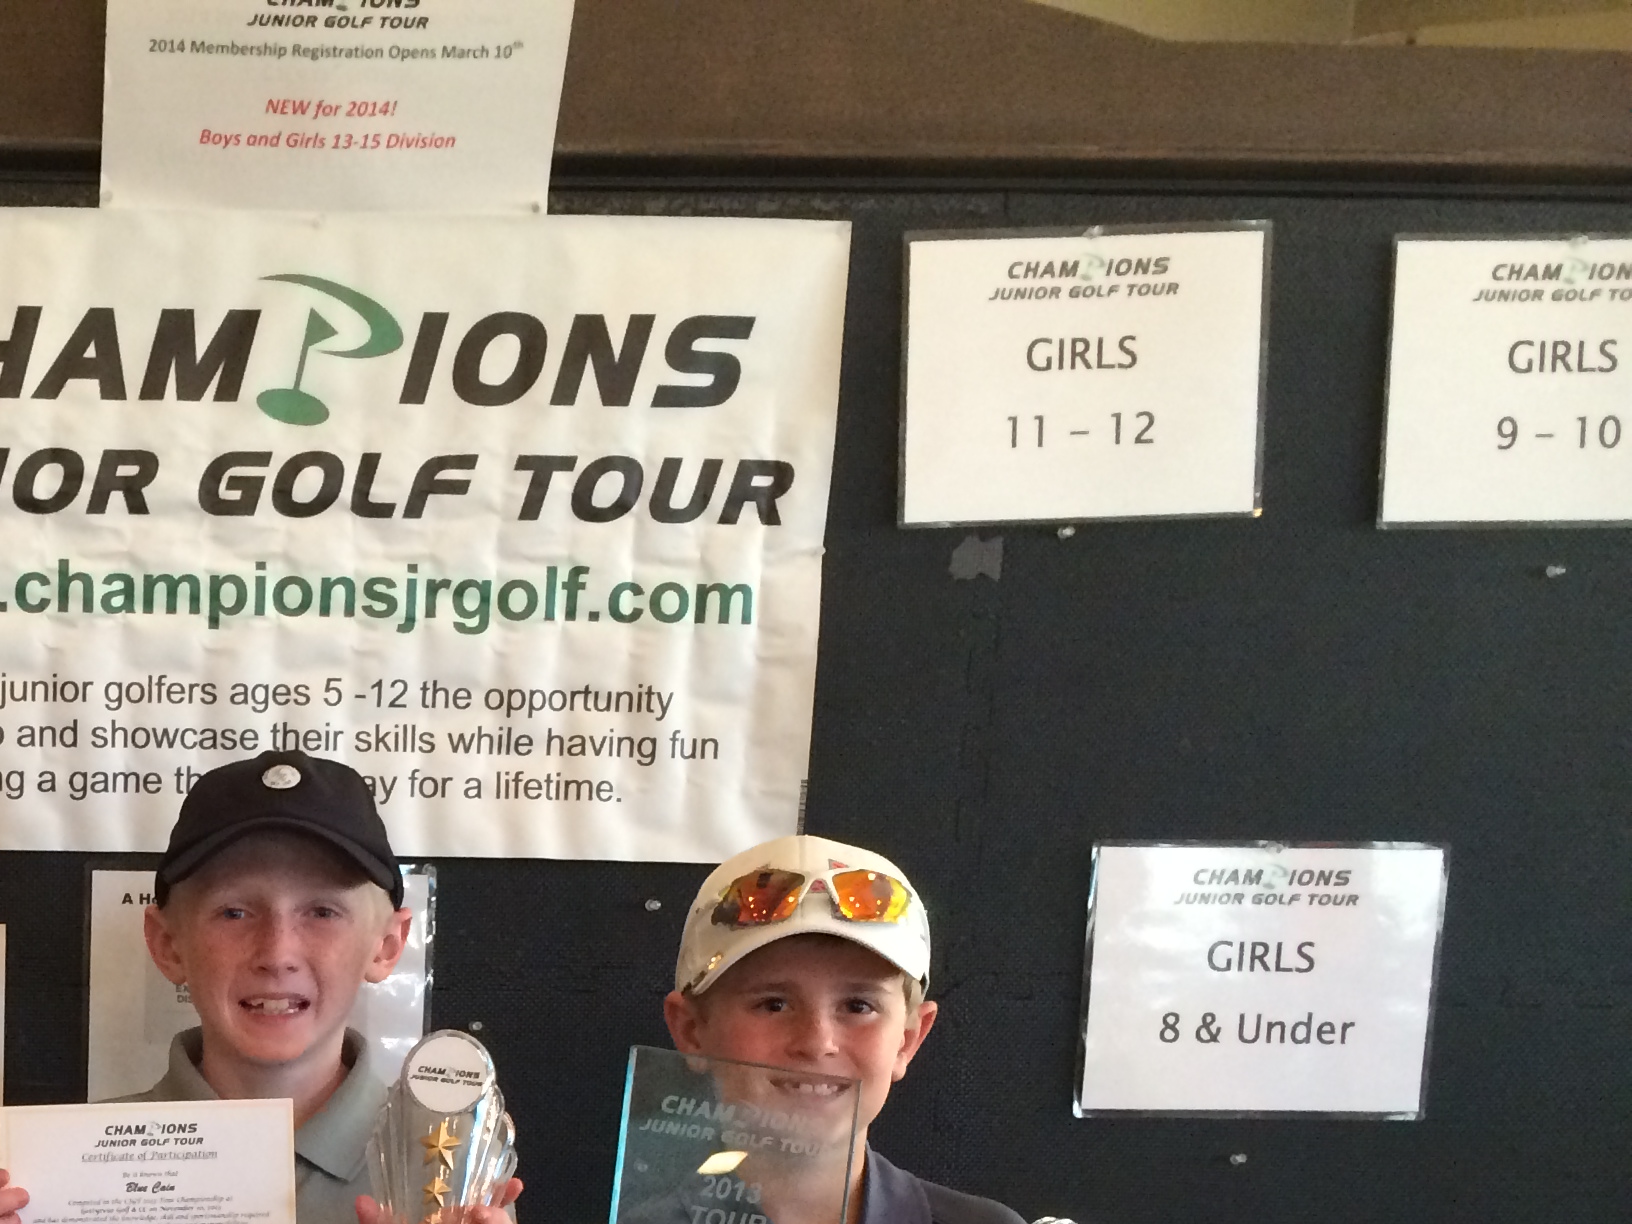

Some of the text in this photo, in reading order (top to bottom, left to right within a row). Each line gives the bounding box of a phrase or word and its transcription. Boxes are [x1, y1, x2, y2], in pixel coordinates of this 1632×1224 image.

[247, 13, 429, 30] JUNIOR GOLF TOUR
[149, 39, 186, 54] 2014
[190, 40, 287, 58] Membership
[291, 43, 384, 60] Registration
[389, 45, 436, 61] Opens
[441, 45, 489, 59] March
[265, 99, 398, 119] NEW for 2014!
[199, 129, 456, 149] Boys and Girls 13-15 Division
[1007, 253, 1170, 281] CHAMPIONS
[989, 282, 1180, 300] JUNIOR GOLF TOUR
[1473, 288, 1602, 303] JUNIOR GOLF
[1026, 336, 1139, 372] GIRLS
[1508, 340, 1619, 374] GIRLS
[1008, 411, 1156, 448] 11 12
[1496, 415, 1622, 450] 9 10
[197, 451, 478, 519] GOLF
[511, 454, 796, 526] TOUR
[103, 671, 217, 712] golfers
[227, 682, 309, 715] ages
[322, 678, 343, 709] 5
[354, 678, 409, 710] -12
[419, 678, 471, 712] the
[483, 683, 674, 722] opportunity
[16, 717, 77, 749] and
[89, 717, 259, 751] showcase
[271, 719, 343, 752] their
[354, 719, 436, 755] skills
[447, 721, 534, 756] while
[543, 724, 656, 769] having
[668, 726, 719, 760] fun
[36, 769, 56, 794] a
[67, 769, 164, 802] game
[409, 769, 455, 797] for
[463, 778, 482, 800] a
[493, 771, 623, 805] lifetime.
[1193, 864, 1352, 889] CHAMPIONS
[1174, 891, 1359, 907] JUNIOR GOLF TOUR
[1207, 940, 1316, 973] GIRLS
[1159, 1012, 1355, 1045] 8 & Under
[95, 1137, 203, 1148] JUNIOR GOLF TOUR
[105, 1121, 197, 1136] CHAMPIONS
[639, 1118, 715, 1141] JUNIOR
[721, 1130, 773, 1148] GOLF
[700, 1175, 762, 1204] 2013
